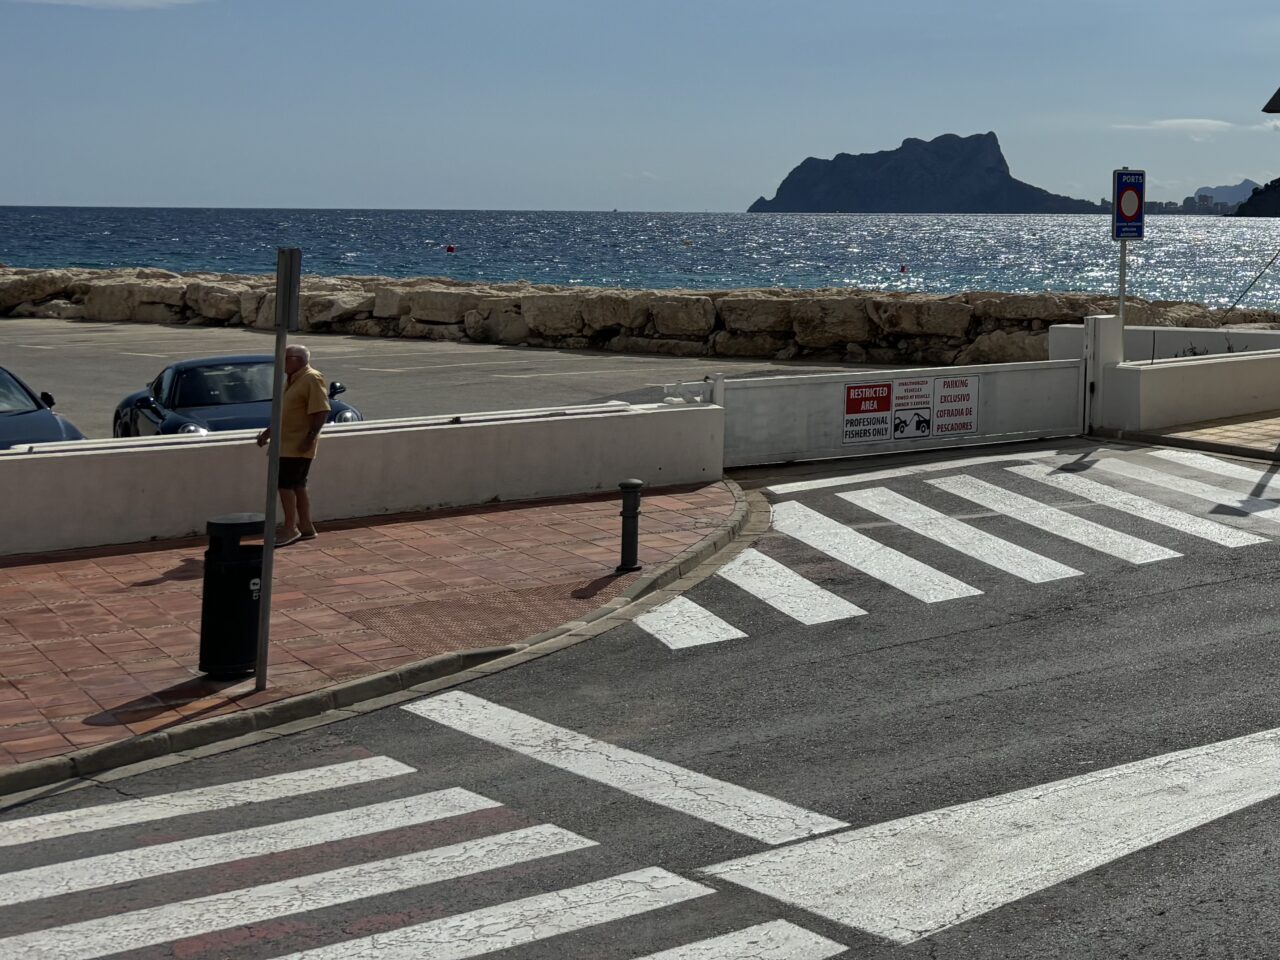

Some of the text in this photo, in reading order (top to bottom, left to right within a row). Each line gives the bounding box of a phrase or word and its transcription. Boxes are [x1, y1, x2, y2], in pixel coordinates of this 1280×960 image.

[1122, 175, 1143, 183] PORTS
[943, 379, 969, 389] PARKING
[850, 386, 888, 399] RESTRICTED
[940, 393, 970, 403] EXCLUSIVO
[860, 400, 878, 410] AREA
[965, 407, 972, 416] DE
[845, 416, 888, 428] PROFESIONAL
[937, 422, 973, 432] PESCADORES
[845, 427, 888, 439] FISHERS ONLY
